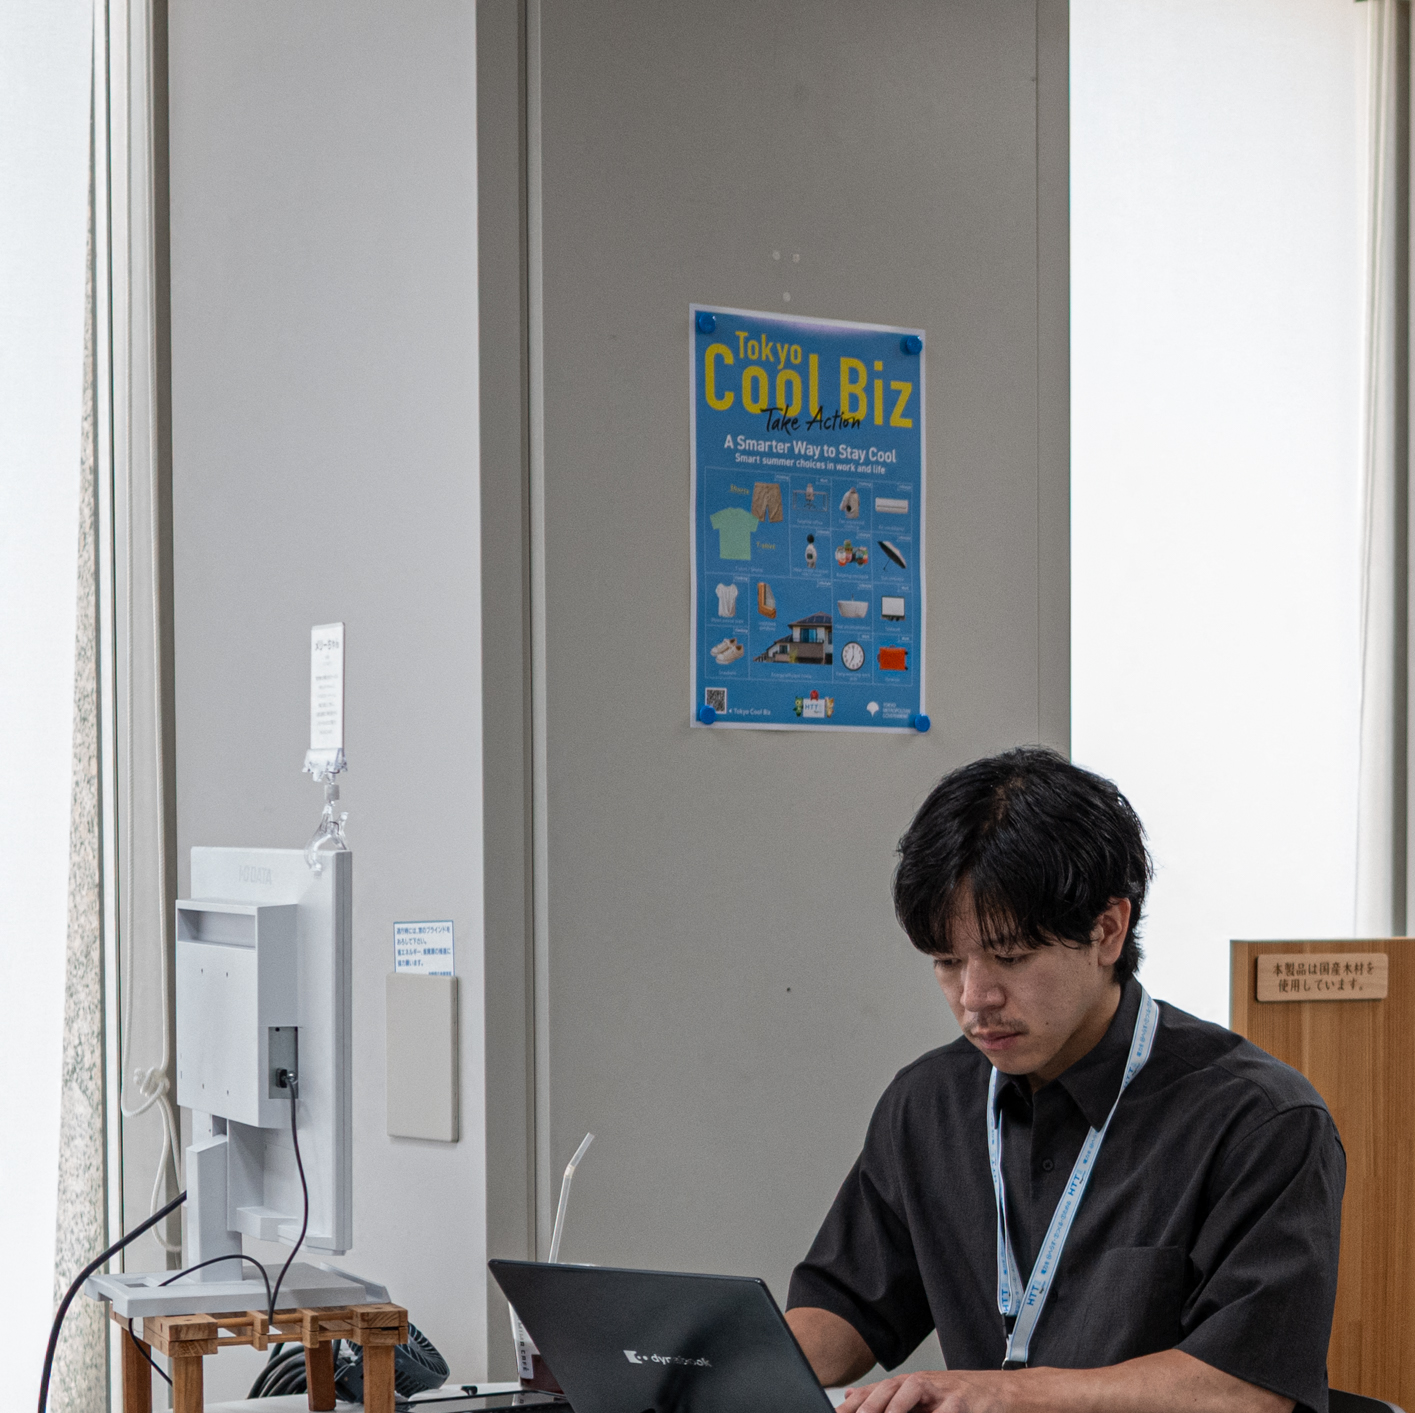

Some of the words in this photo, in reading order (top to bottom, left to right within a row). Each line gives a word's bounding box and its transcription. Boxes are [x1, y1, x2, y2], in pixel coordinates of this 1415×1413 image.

[735, 331, 801, 369] Tokyo
[705, 343, 819, 420] Cool
[840, 357, 912, 428] Biz
[760, 404, 800, 436] Take
[805, 406, 860, 430] Action
[724, 434, 733, 449] A
[737, 436, 791, 453] Smarter
[793, 441, 820, 459] Way
[823, 444, 835, 456] to
[839, 445, 865, 463] Stay
[869, 448, 896, 463] Cool
[735, 453, 759, 464] Smart
[762, 457, 794, 467] summer
[796, 457, 825, 469] choices
[827, 460, 834, 470] in
[836, 460, 855, 472] work
[857, 463, 870, 473] and
[873, 465, 885, 474] life
[734, 708, 749, 716] Tokyo
[1273, 962, 1374, 977] 本製品は国産木材を
[1279, 978, 1363, 993] 使用しています。
[1067, 1175, 1080, 1196] HTT
[1027, 1285, 1039, 1306] HTT
